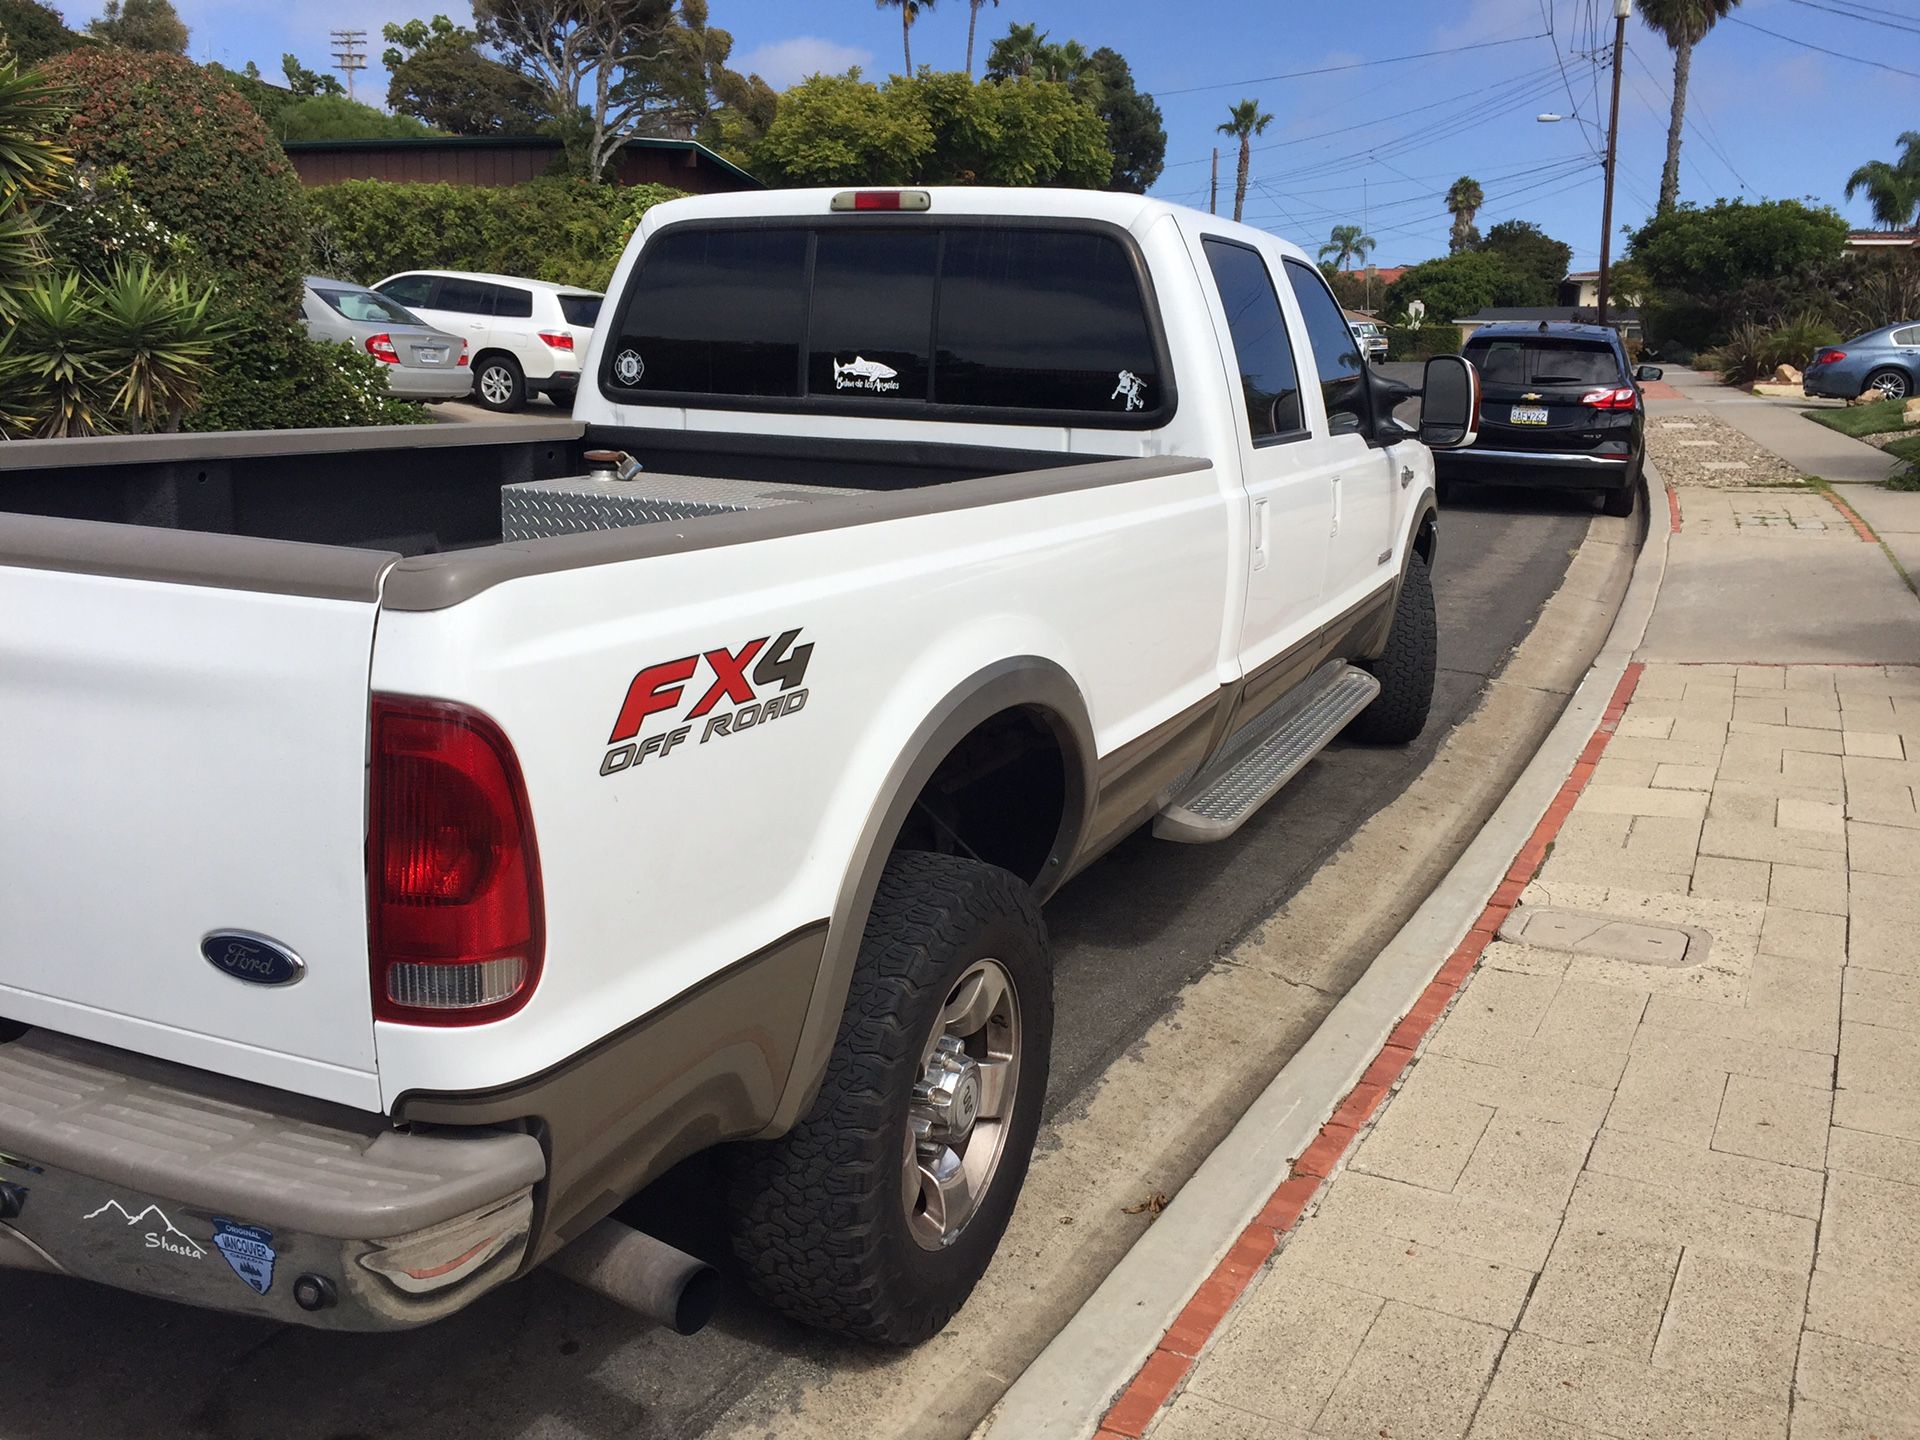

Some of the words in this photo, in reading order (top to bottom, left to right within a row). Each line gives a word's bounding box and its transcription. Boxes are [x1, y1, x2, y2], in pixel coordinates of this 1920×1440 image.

[607, 627, 816, 745] FX4
[599, 725, 692, 777] OFF
[699, 688, 810, 745] ROAD
[223, 942, 275, 975] Ford
[144, 1232, 201, 1260] Shasta
[222, 1234, 268, 1259] VANCOUVER
[225, 1224, 261, 1240] ORIGINAL
